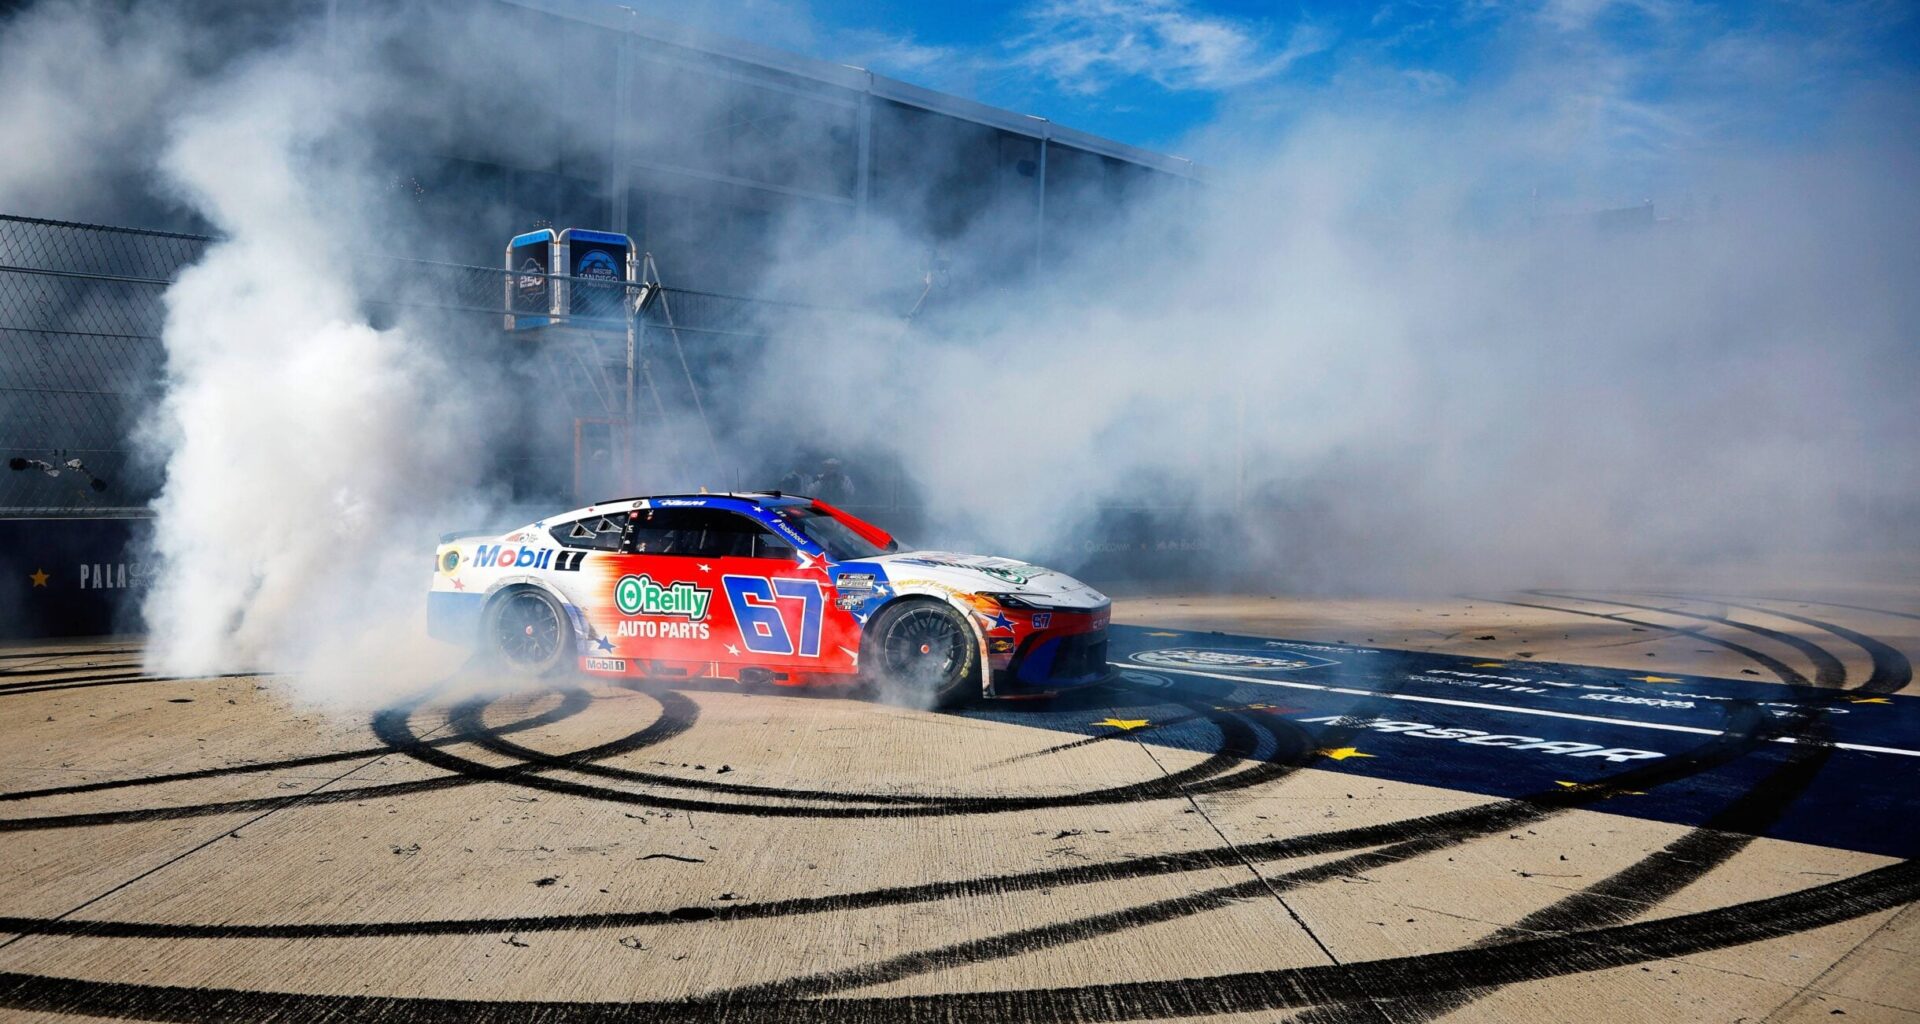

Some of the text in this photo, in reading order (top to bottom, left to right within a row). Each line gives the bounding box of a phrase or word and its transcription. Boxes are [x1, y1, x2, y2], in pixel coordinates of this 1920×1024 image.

[778, 522, 808, 545] Robinhood
[473, 544, 553, 570] Mobil
[80, 563, 127, 589] PALA
[621, 577, 707, 617] O'Reilly
[722, 574, 825, 657] 67
[1032, 612, 1052, 629] 67
[617, 621, 710, 640] AUTO PARTS
[587, 659, 614, 670] Mobil
[1294, 714, 1669, 763] NASCAR
